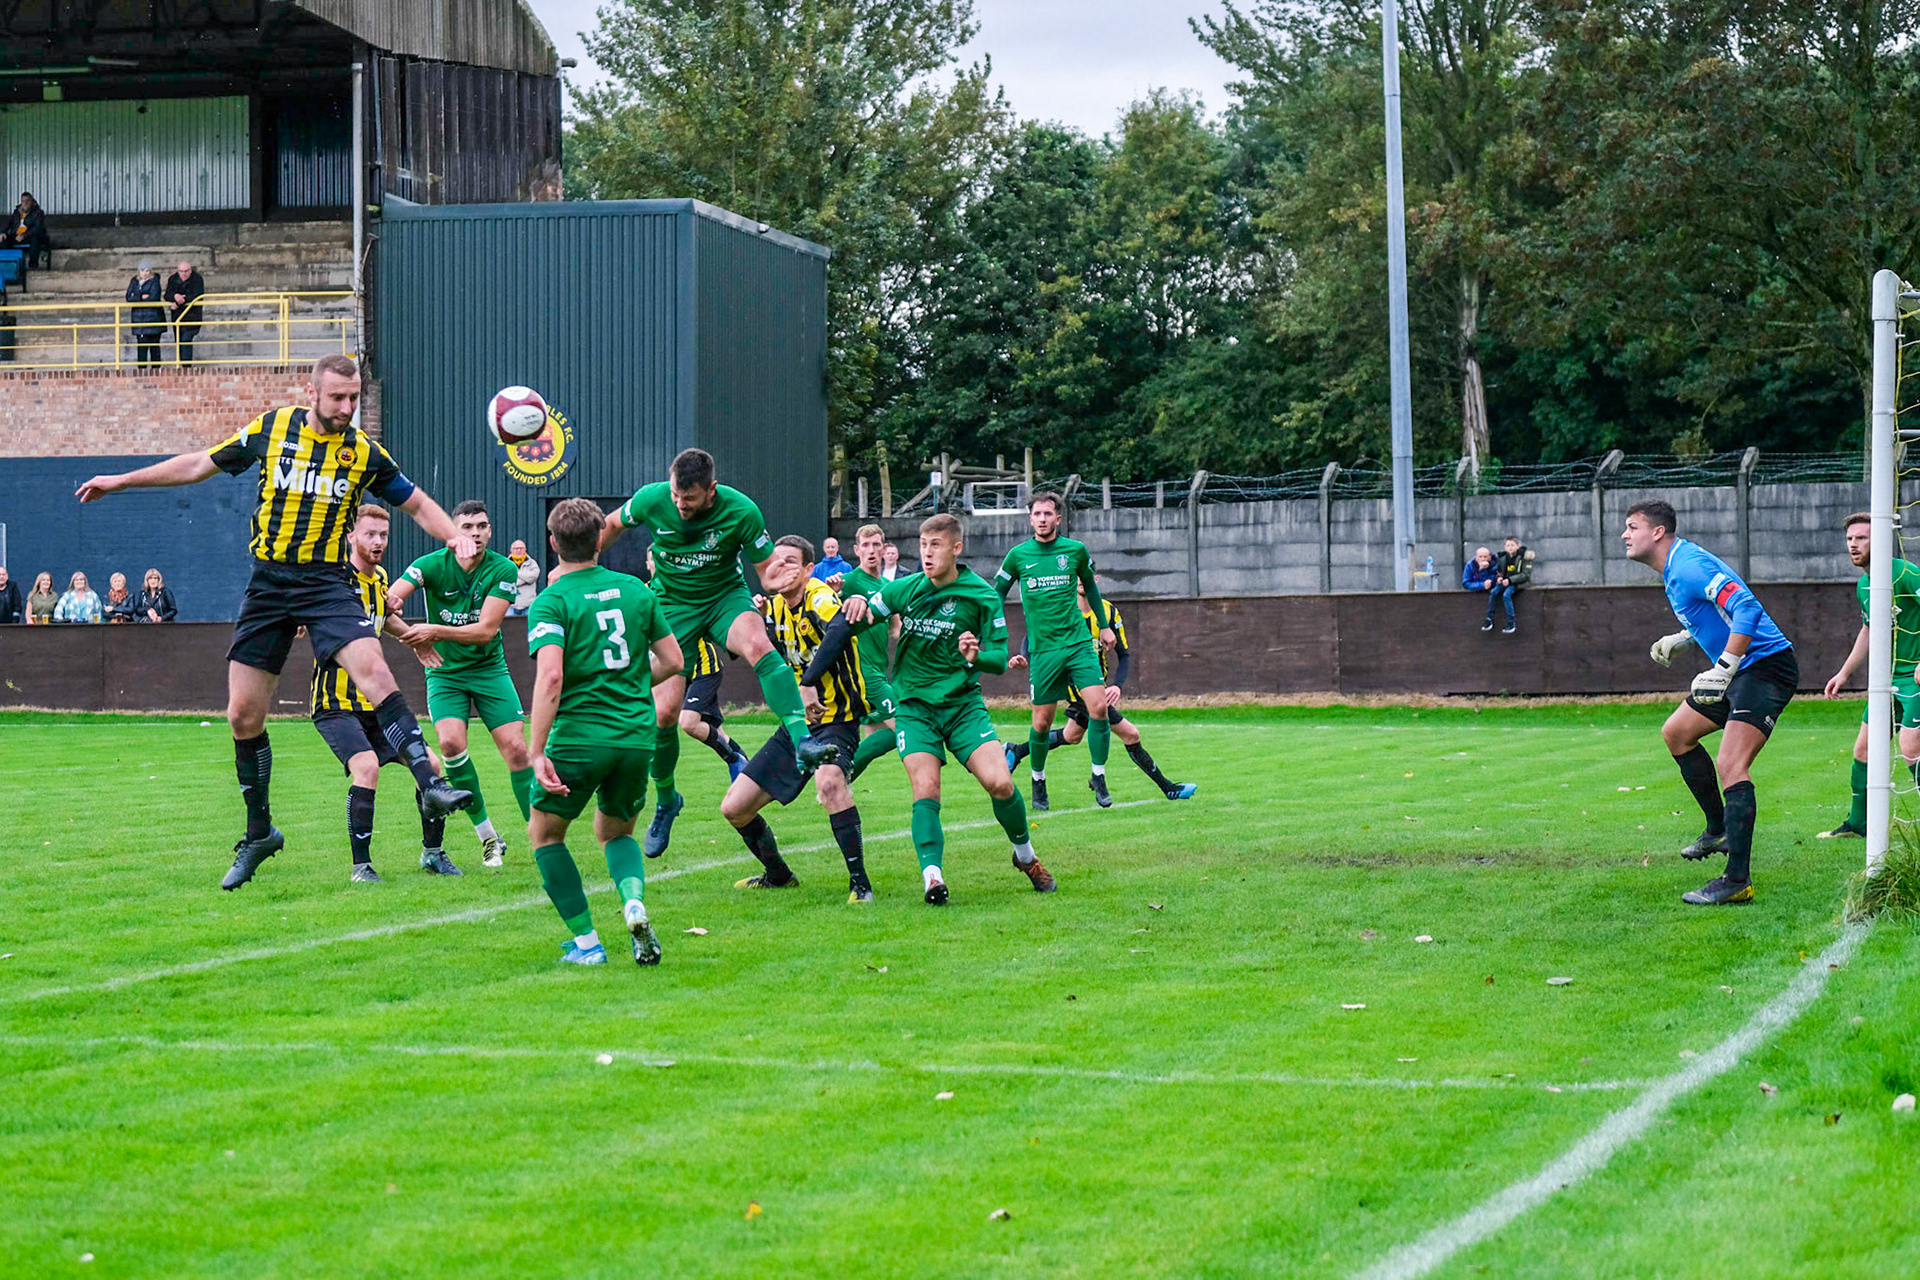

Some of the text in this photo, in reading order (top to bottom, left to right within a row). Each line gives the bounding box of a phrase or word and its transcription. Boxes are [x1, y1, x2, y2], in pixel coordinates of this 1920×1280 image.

[273, 464, 350, 498] Milne
[503, 461, 569, 485] FOUNDED 1884
[596, 608, 630, 669] 3
[882, 699, 896, 714] 2
[897, 731, 905, 752] 6
